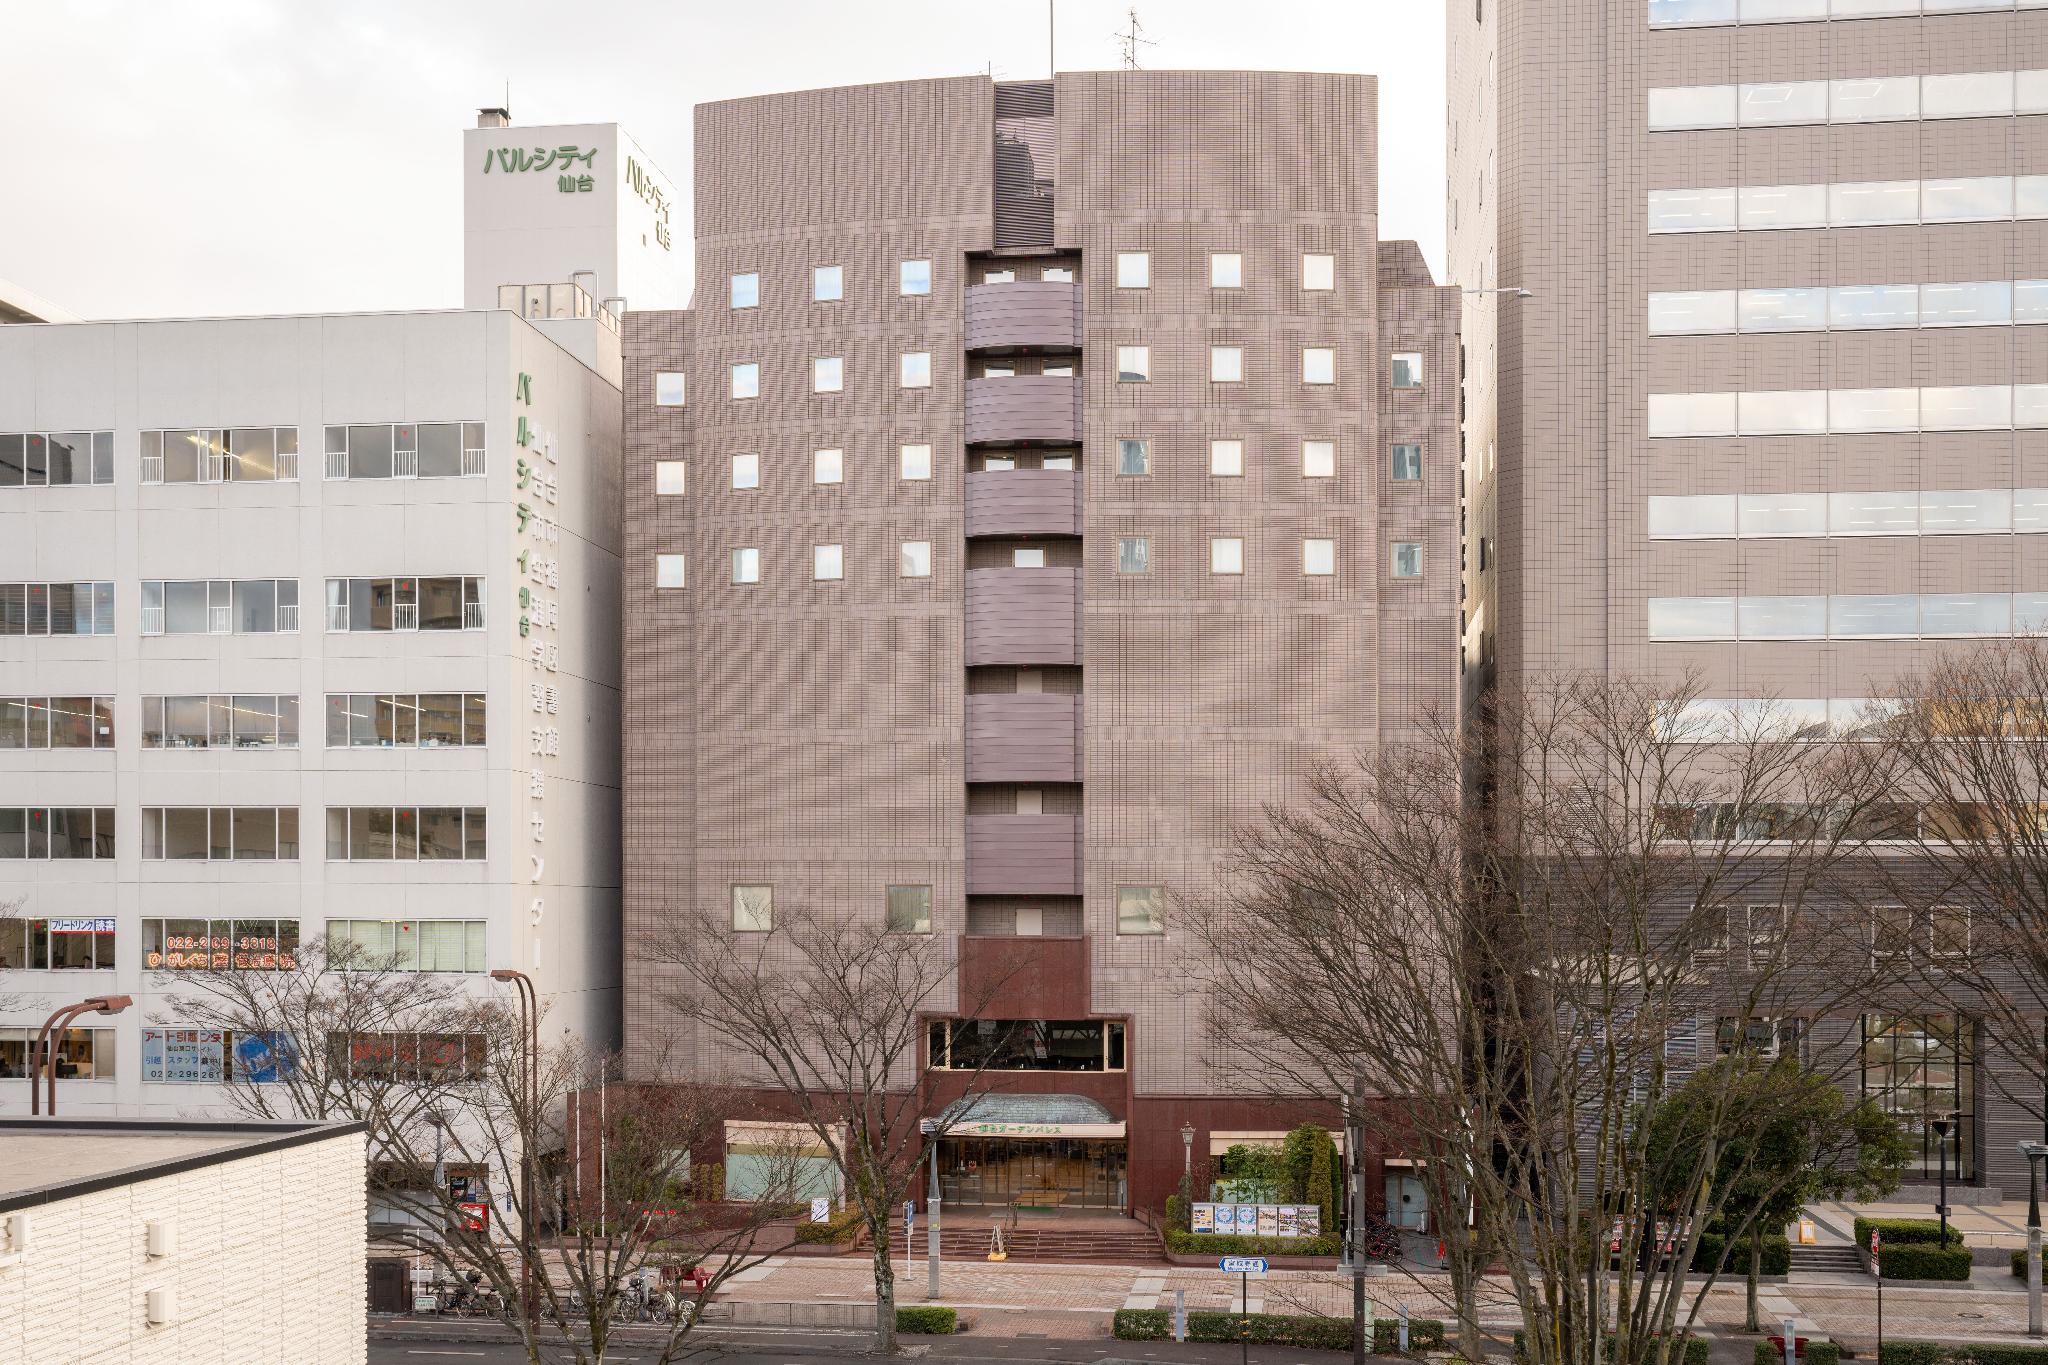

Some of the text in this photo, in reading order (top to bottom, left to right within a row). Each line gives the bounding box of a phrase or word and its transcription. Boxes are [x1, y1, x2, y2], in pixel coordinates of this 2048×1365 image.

[484, 145, 598, 174] パルシティ
[557, 174, 595, 193] 仙台
[51, 920, 93, 930] フリードリンク
